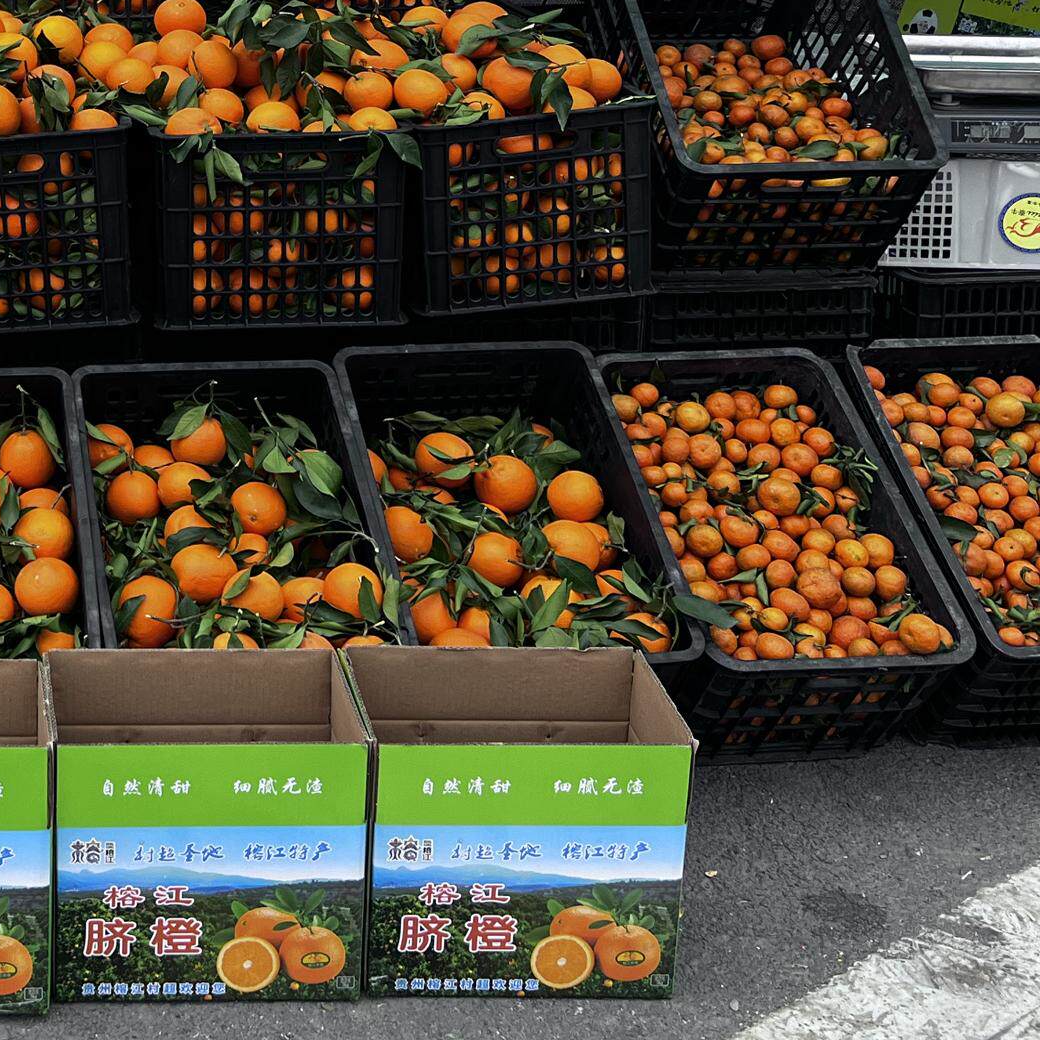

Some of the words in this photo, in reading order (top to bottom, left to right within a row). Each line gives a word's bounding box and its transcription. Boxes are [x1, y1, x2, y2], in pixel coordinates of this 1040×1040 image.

[101, 778, 192, 797] 自然清甜
[233, 776, 324, 795] 细腻无渣
[421, 778, 512, 796] 自然清甜
[553, 776, 645, 796] 细腻无渣
[103, 885, 195, 909] 榕江
[418, 882, 511, 906] 榕江
[84, 917, 203, 957] 脐橙
[397, 913, 517, 953] 脐橙
